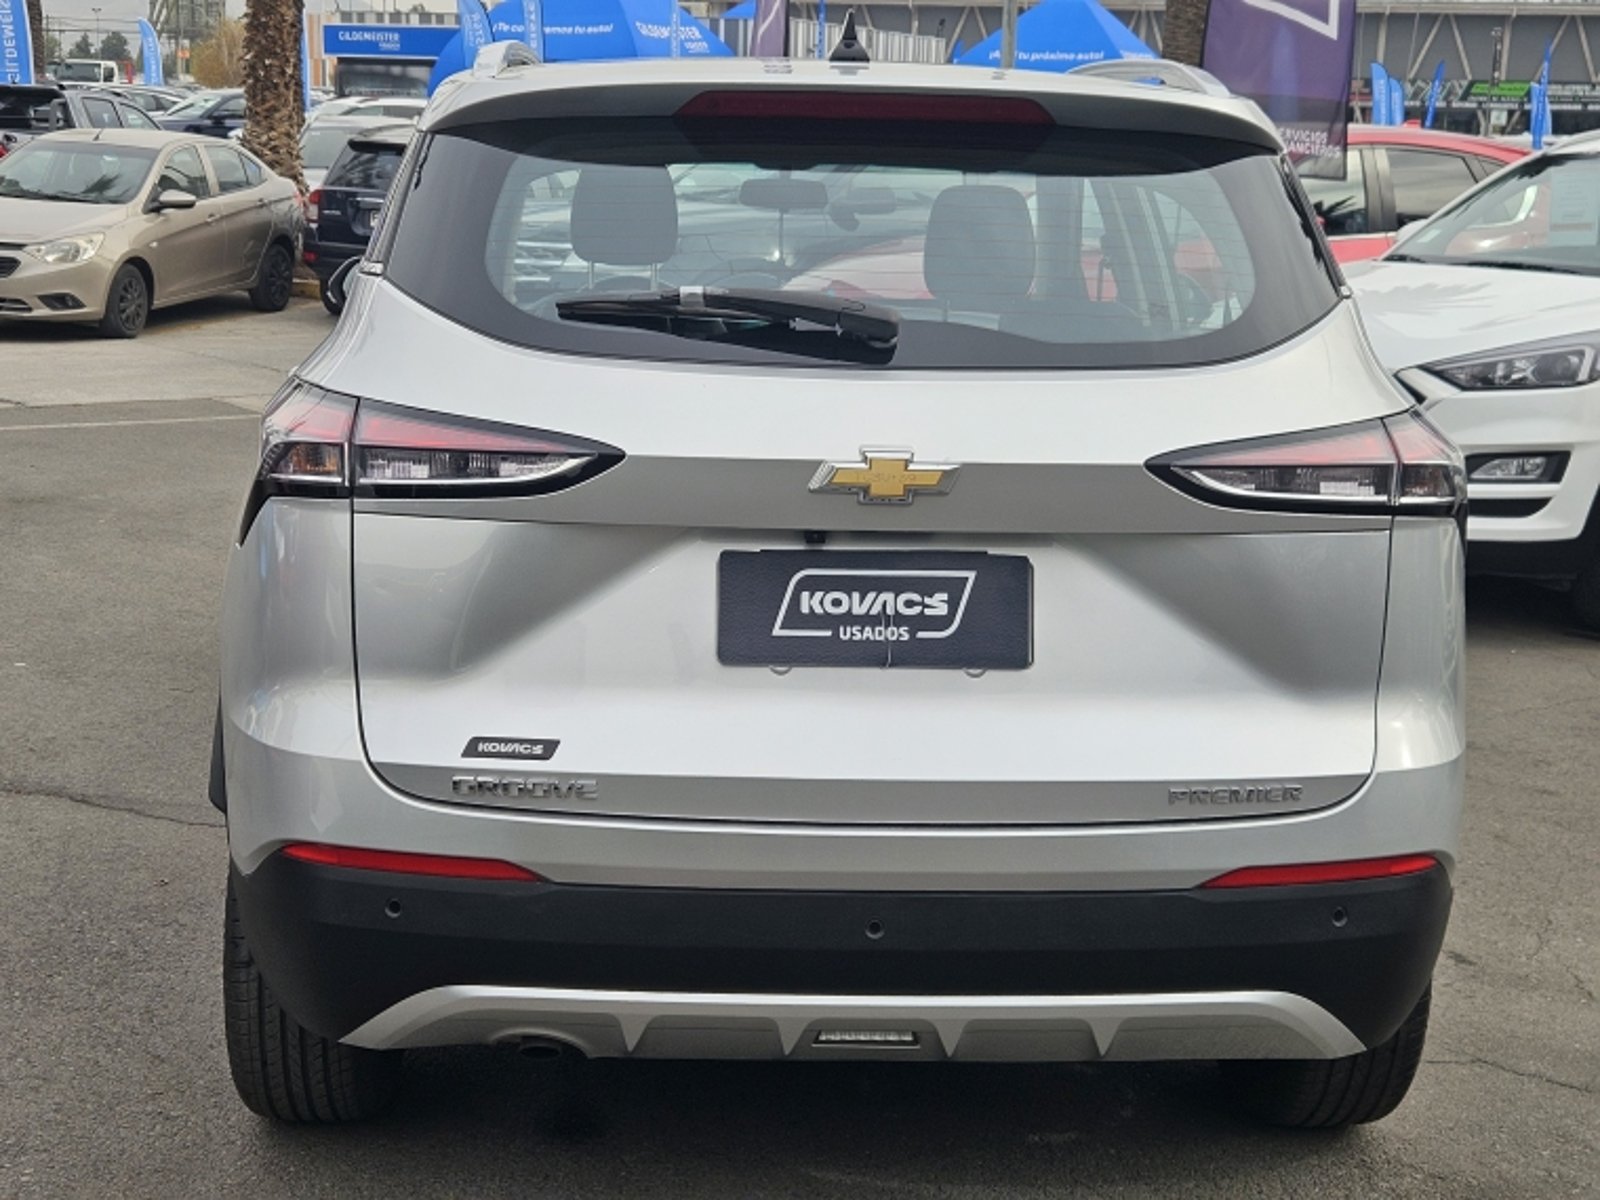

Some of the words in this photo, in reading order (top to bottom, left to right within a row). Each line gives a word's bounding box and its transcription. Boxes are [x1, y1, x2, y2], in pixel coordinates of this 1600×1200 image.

[800, 590, 948, 616] KOVACS
[839, 625, 910, 641] USADOS
[477, 742, 544, 755] KOVACS
[452, 775, 599, 800] GROOVE
[1168, 784, 1303, 806] PREMIER
